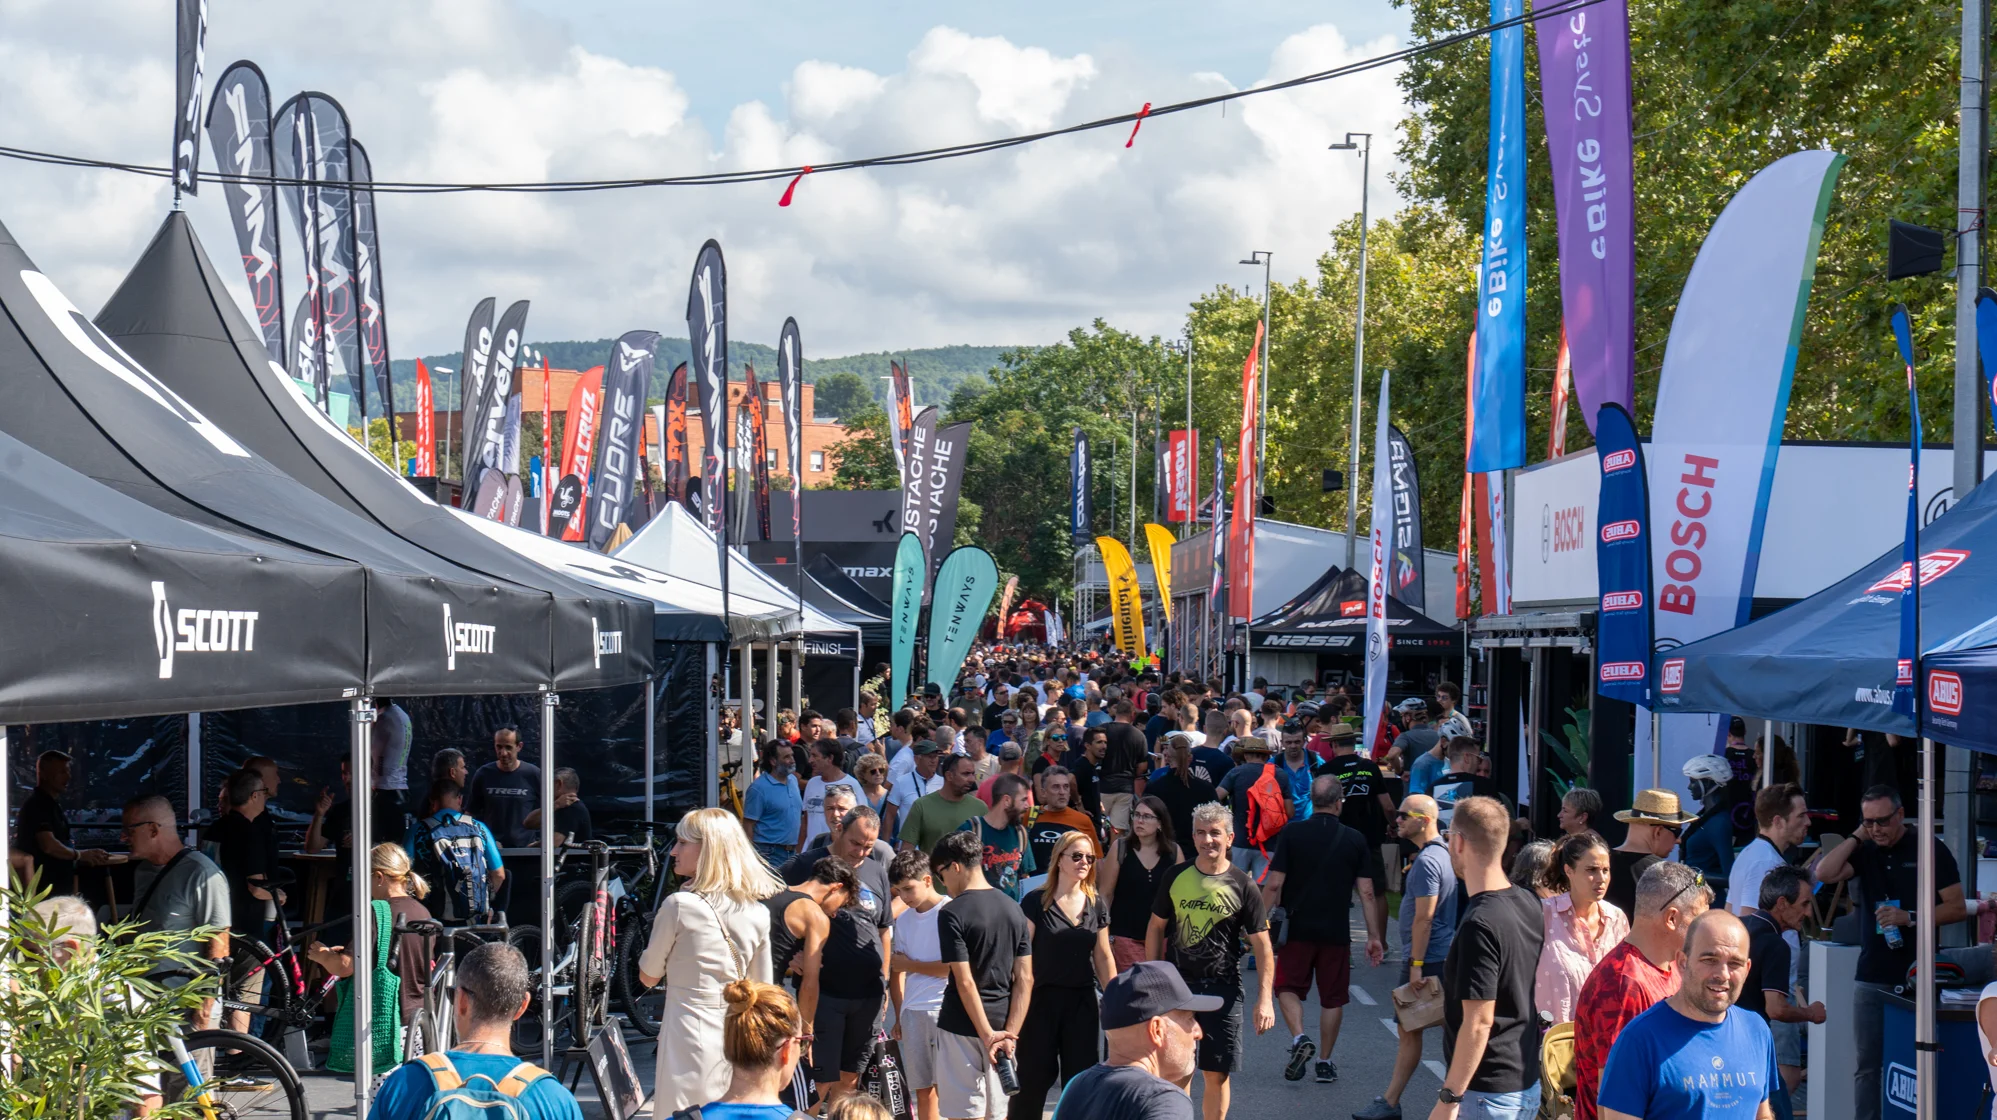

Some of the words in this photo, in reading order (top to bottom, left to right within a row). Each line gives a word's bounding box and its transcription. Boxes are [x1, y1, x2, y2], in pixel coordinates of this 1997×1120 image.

[577, 387, 596, 456] CRUZ
[600, 387, 634, 530] CUORE
[1553, 506, 1585, 552] BOSCH
[1659, 453, 1719, 616] BOSCH
[1372, 528, 1383, 620] BOSCH
[899, 566, 914, 645] TENWAYS
[944, 574, 976, 644] TENWAYS
[175, 608, 259, 652] SCOTT
[454, 621, 496, 654] SCOTT
[599, 630, 622, 654] SCOTT
[1932, 679, 1959, 705] ABUS
[486, 787, 529, 796] TREK
[223, 1002, 250, 1011] SCOTT
[1683, 1071, 1757, 1092] MAMMUT
